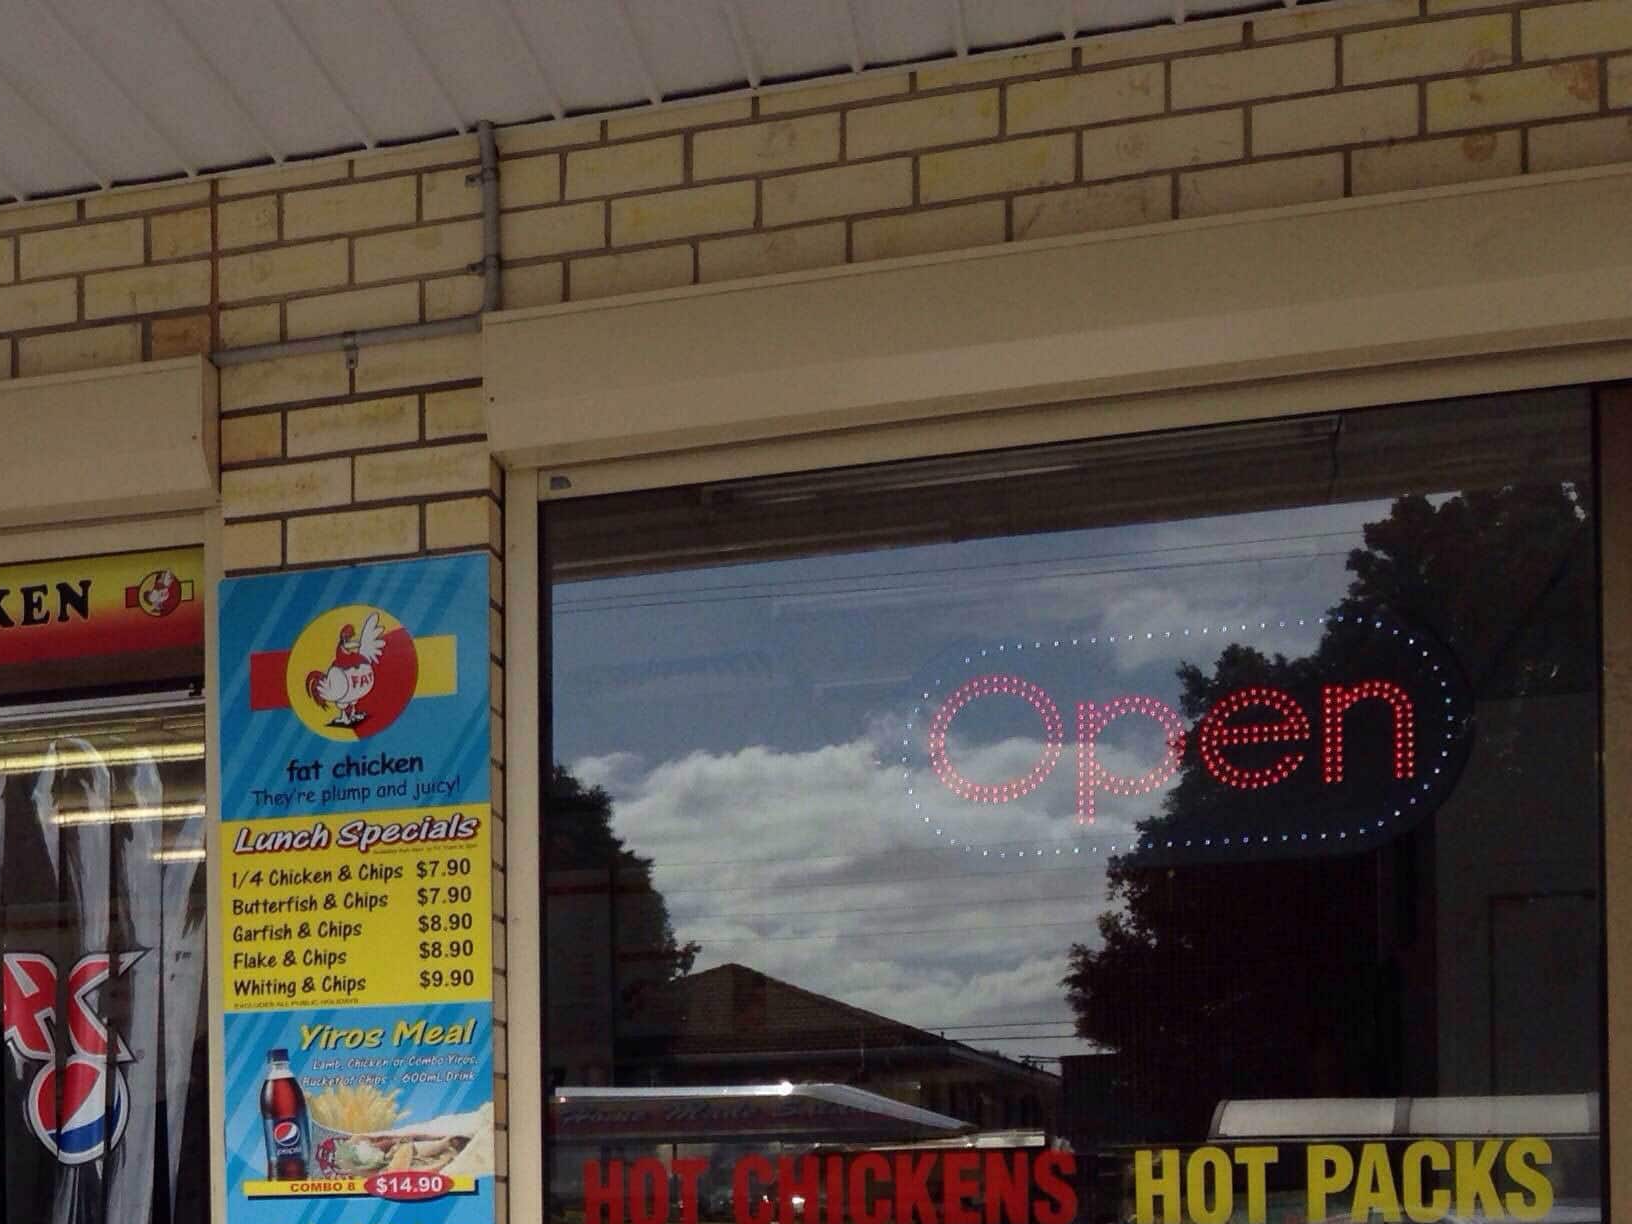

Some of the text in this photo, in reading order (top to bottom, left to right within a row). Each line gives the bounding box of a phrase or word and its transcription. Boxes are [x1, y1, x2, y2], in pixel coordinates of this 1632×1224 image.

[928, 672, 1416, 826] Open
[287, 752, 424, 782] fat chicken
[252, 776, 461, 807] They're plump and juicy!
[233, 812, 480, 856] Lunch Specials
[231, 862, 403, 890] 1/4 Chicken & Chips
[416, 858, 471, 879] $7.90
[233, 892, 388, 916] Butterfish & Chips
[417, 885, 472, 905] $7.90
[233, 920, 362, 942] Garfish & Chips
[418, 913, 472, 933] $8.90
[233, 949, 347, 970] Flake & Chips
[419, 940, 473, 960] $8.90
[233, 974, 366, 997] Whiting & Chips
[419, 969, 474, 988] $9.90
[300, 1017, 477, 1051] Yiros Meal
[408, 1055, 445, 1066] Combo
[446, 1071, 475, 1081] Drink
[290, 1182, 342, 1193] COMBO
[376, 1176, 443, 1194] $14.90
[1306, 1136, 1555, 1224] PACKS
